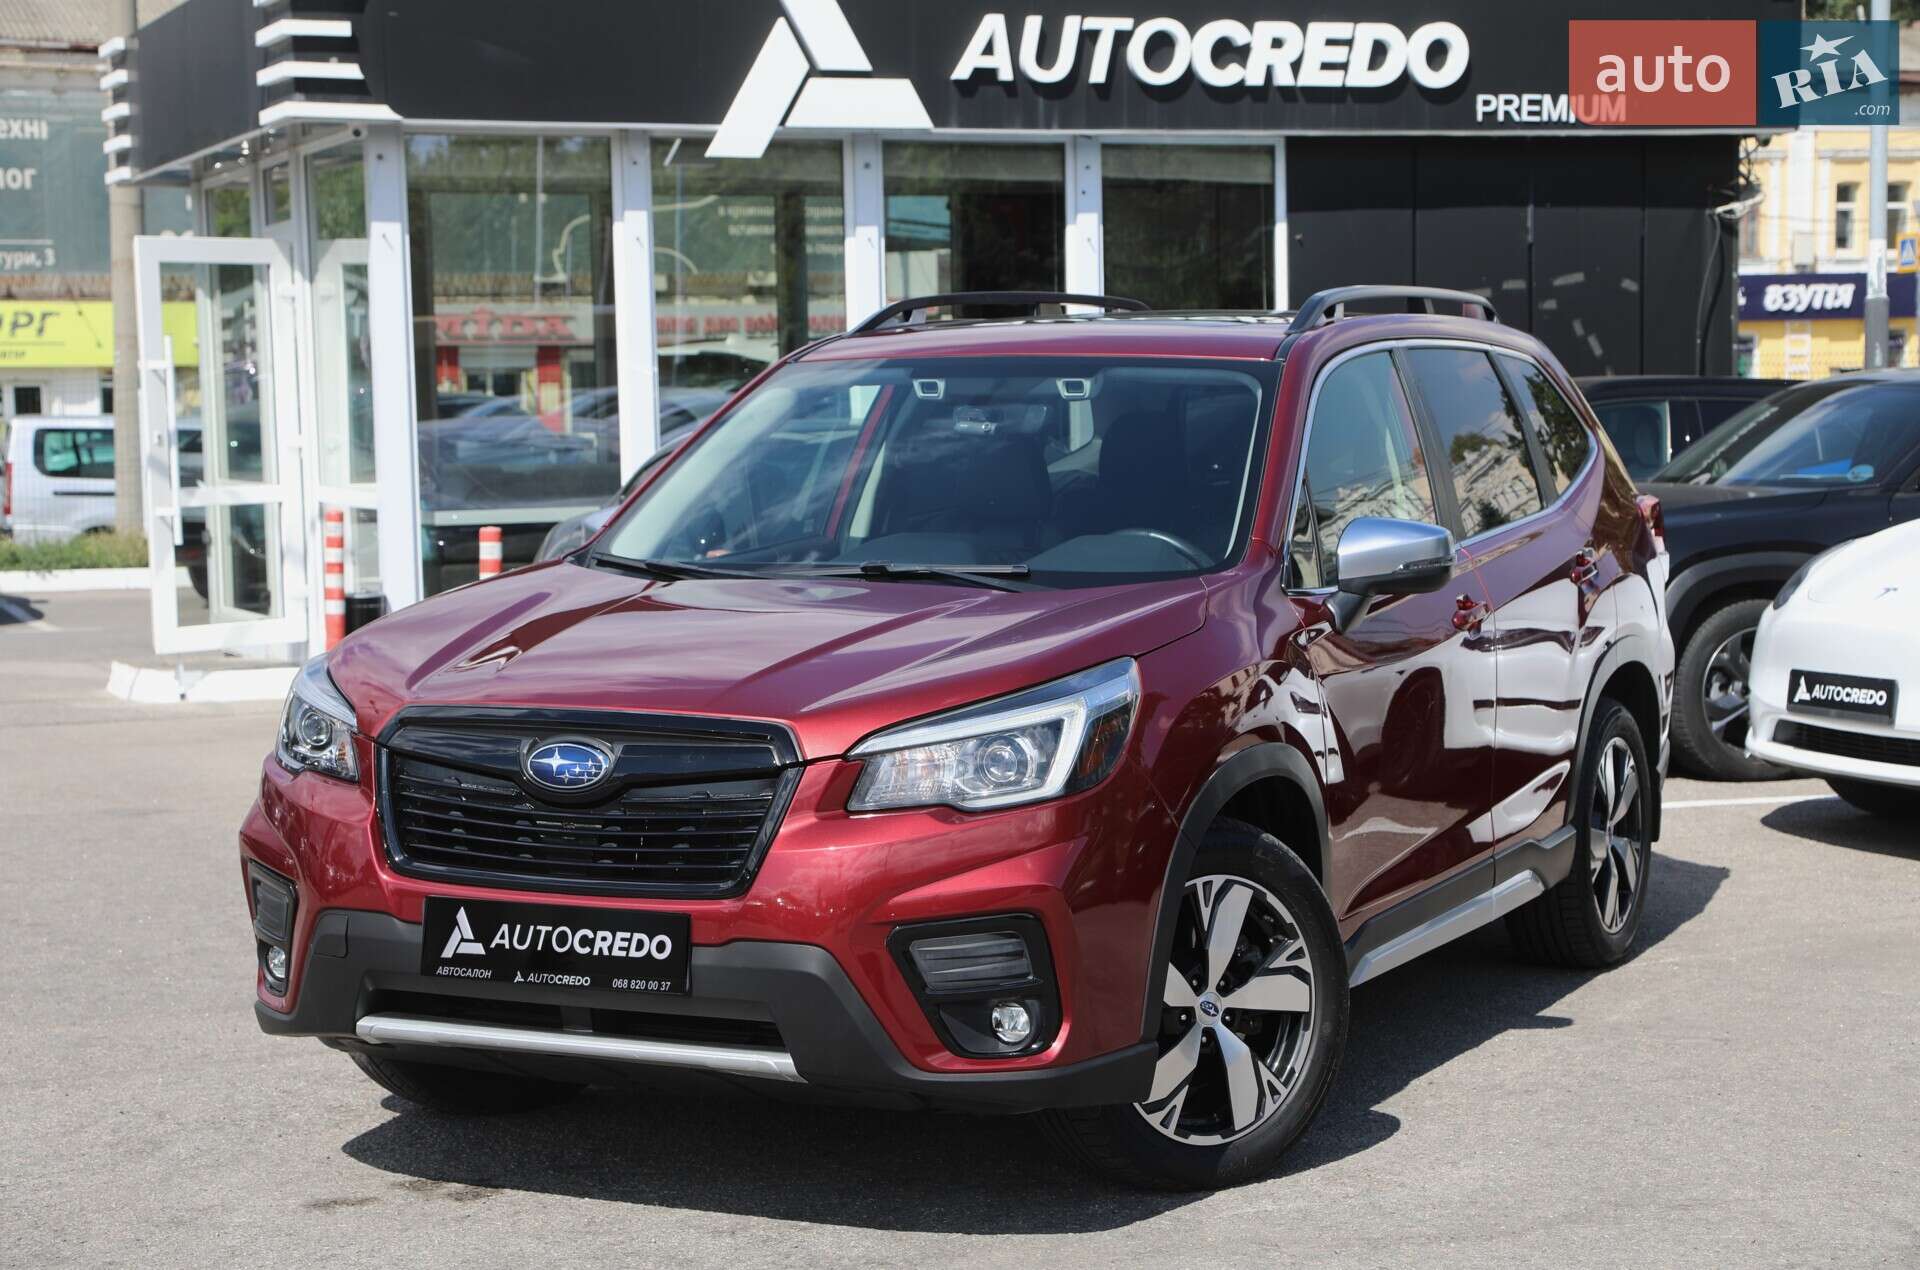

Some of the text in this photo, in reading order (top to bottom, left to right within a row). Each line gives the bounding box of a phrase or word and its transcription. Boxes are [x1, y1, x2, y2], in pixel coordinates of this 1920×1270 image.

[950, 13, 1470, 89] AUTOCREDO
[1475, 93, 1627, 123] PREMIUM
[1811, 683, 1888, 706] AUTOCREDO
[489, 923, 673, 960] AUTOCREDO
[436, 966, 492, 979] АВТОСАЛОН
[526, 972, 591, 986] AUTOCREDO
[612, 978, 671, 991] 068 820 00 37
